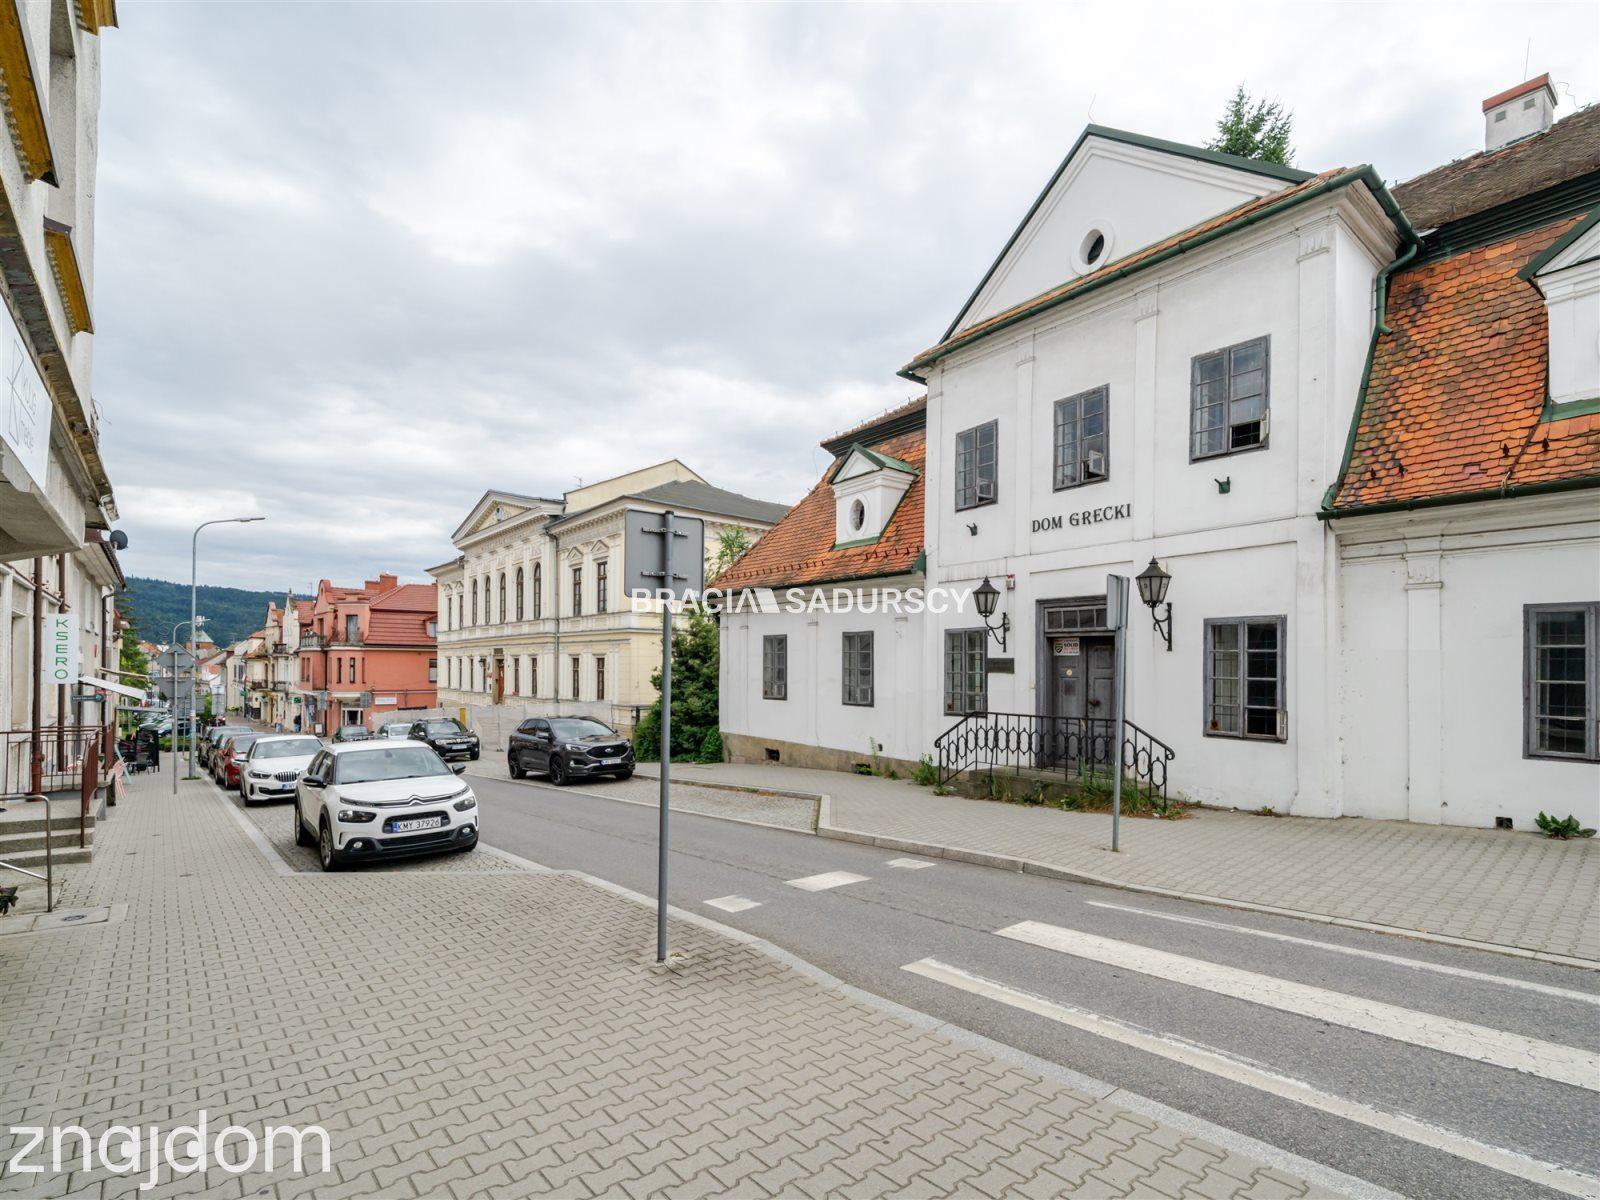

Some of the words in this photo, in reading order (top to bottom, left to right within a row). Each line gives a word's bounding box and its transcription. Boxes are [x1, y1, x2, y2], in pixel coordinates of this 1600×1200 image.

[1031, 515, 1063, 533] DOM
[1069, 503, 1131, 527] GRECKI
[55, 619, 69, 680] KSERO
[398, 821, 413, 831] KMY
[416, 818, 440, 829] 37926
